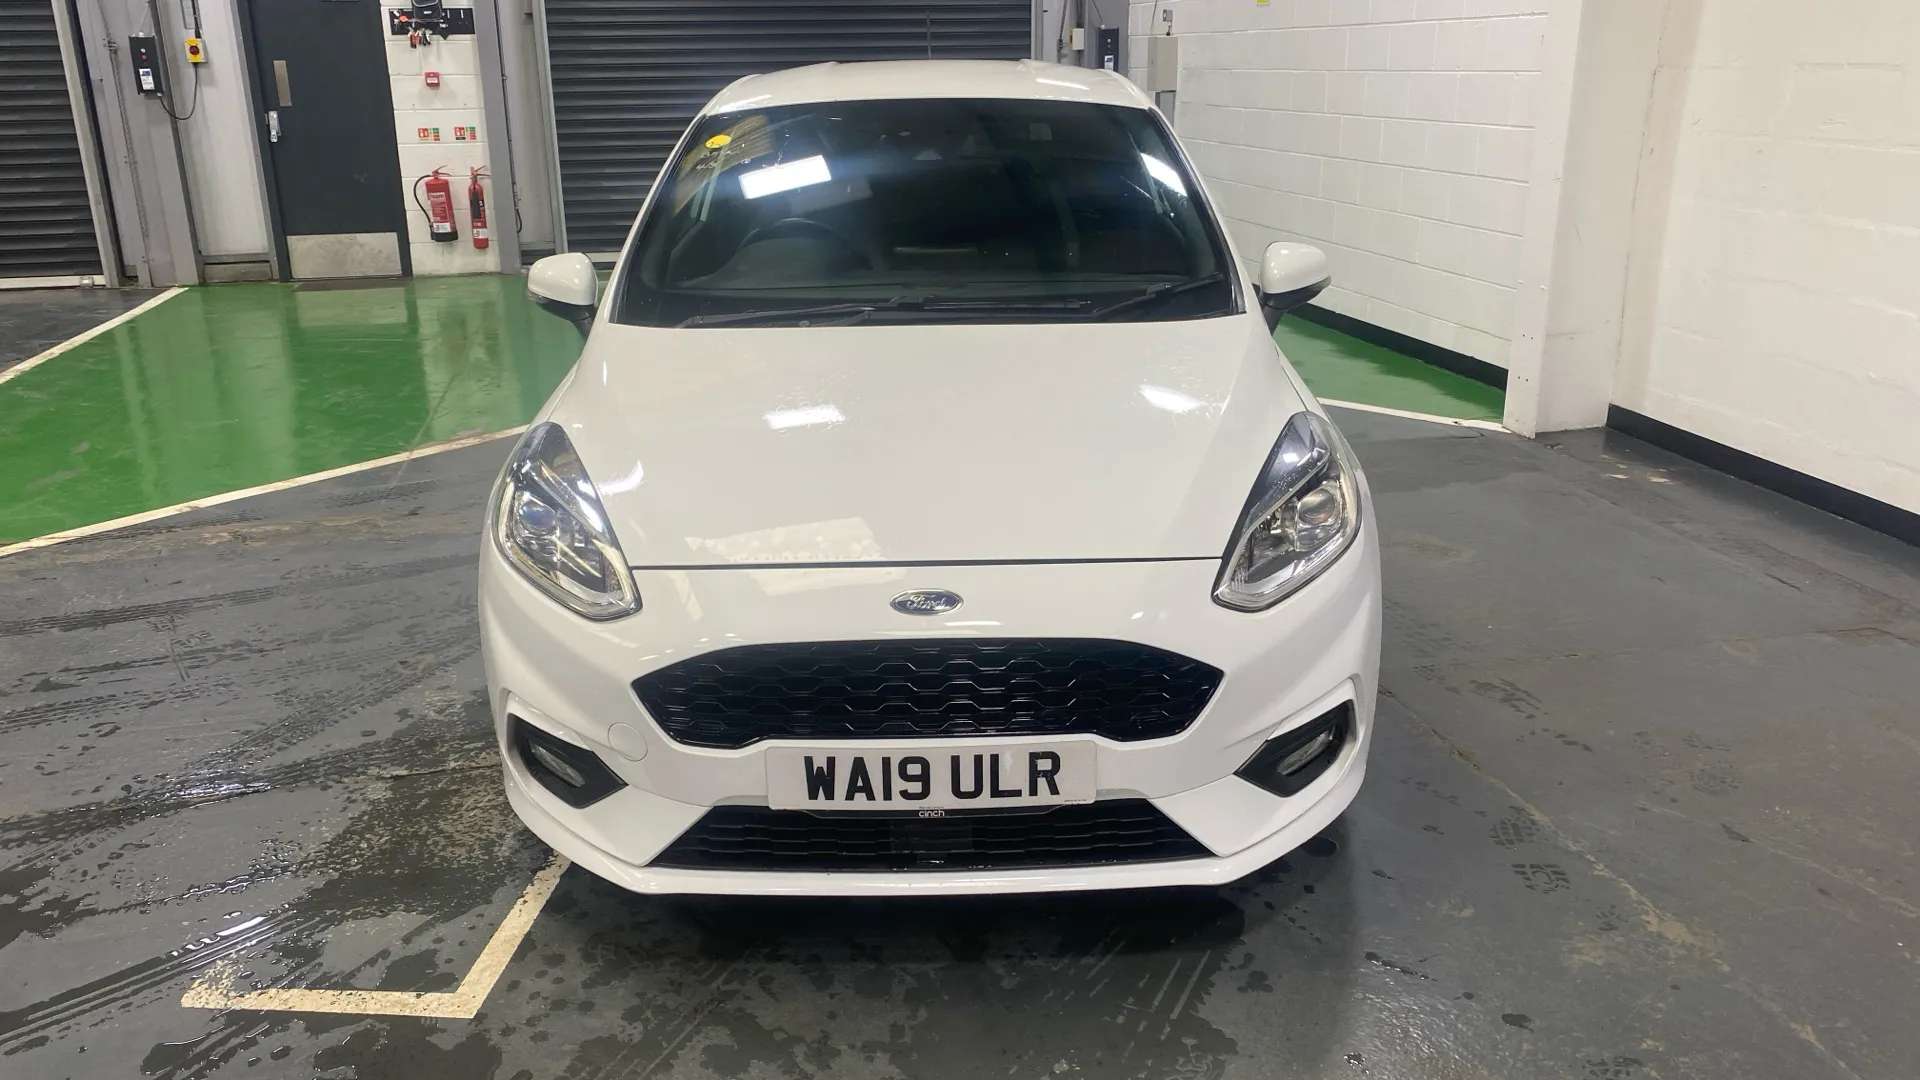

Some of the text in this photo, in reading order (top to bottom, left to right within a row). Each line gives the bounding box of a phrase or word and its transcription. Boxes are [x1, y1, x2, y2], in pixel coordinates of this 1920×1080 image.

[906, 594, 947, 610] Ford
[804, 751, 1062, 801] WA19 ULR
[918, 808, 945, 817] cinch
